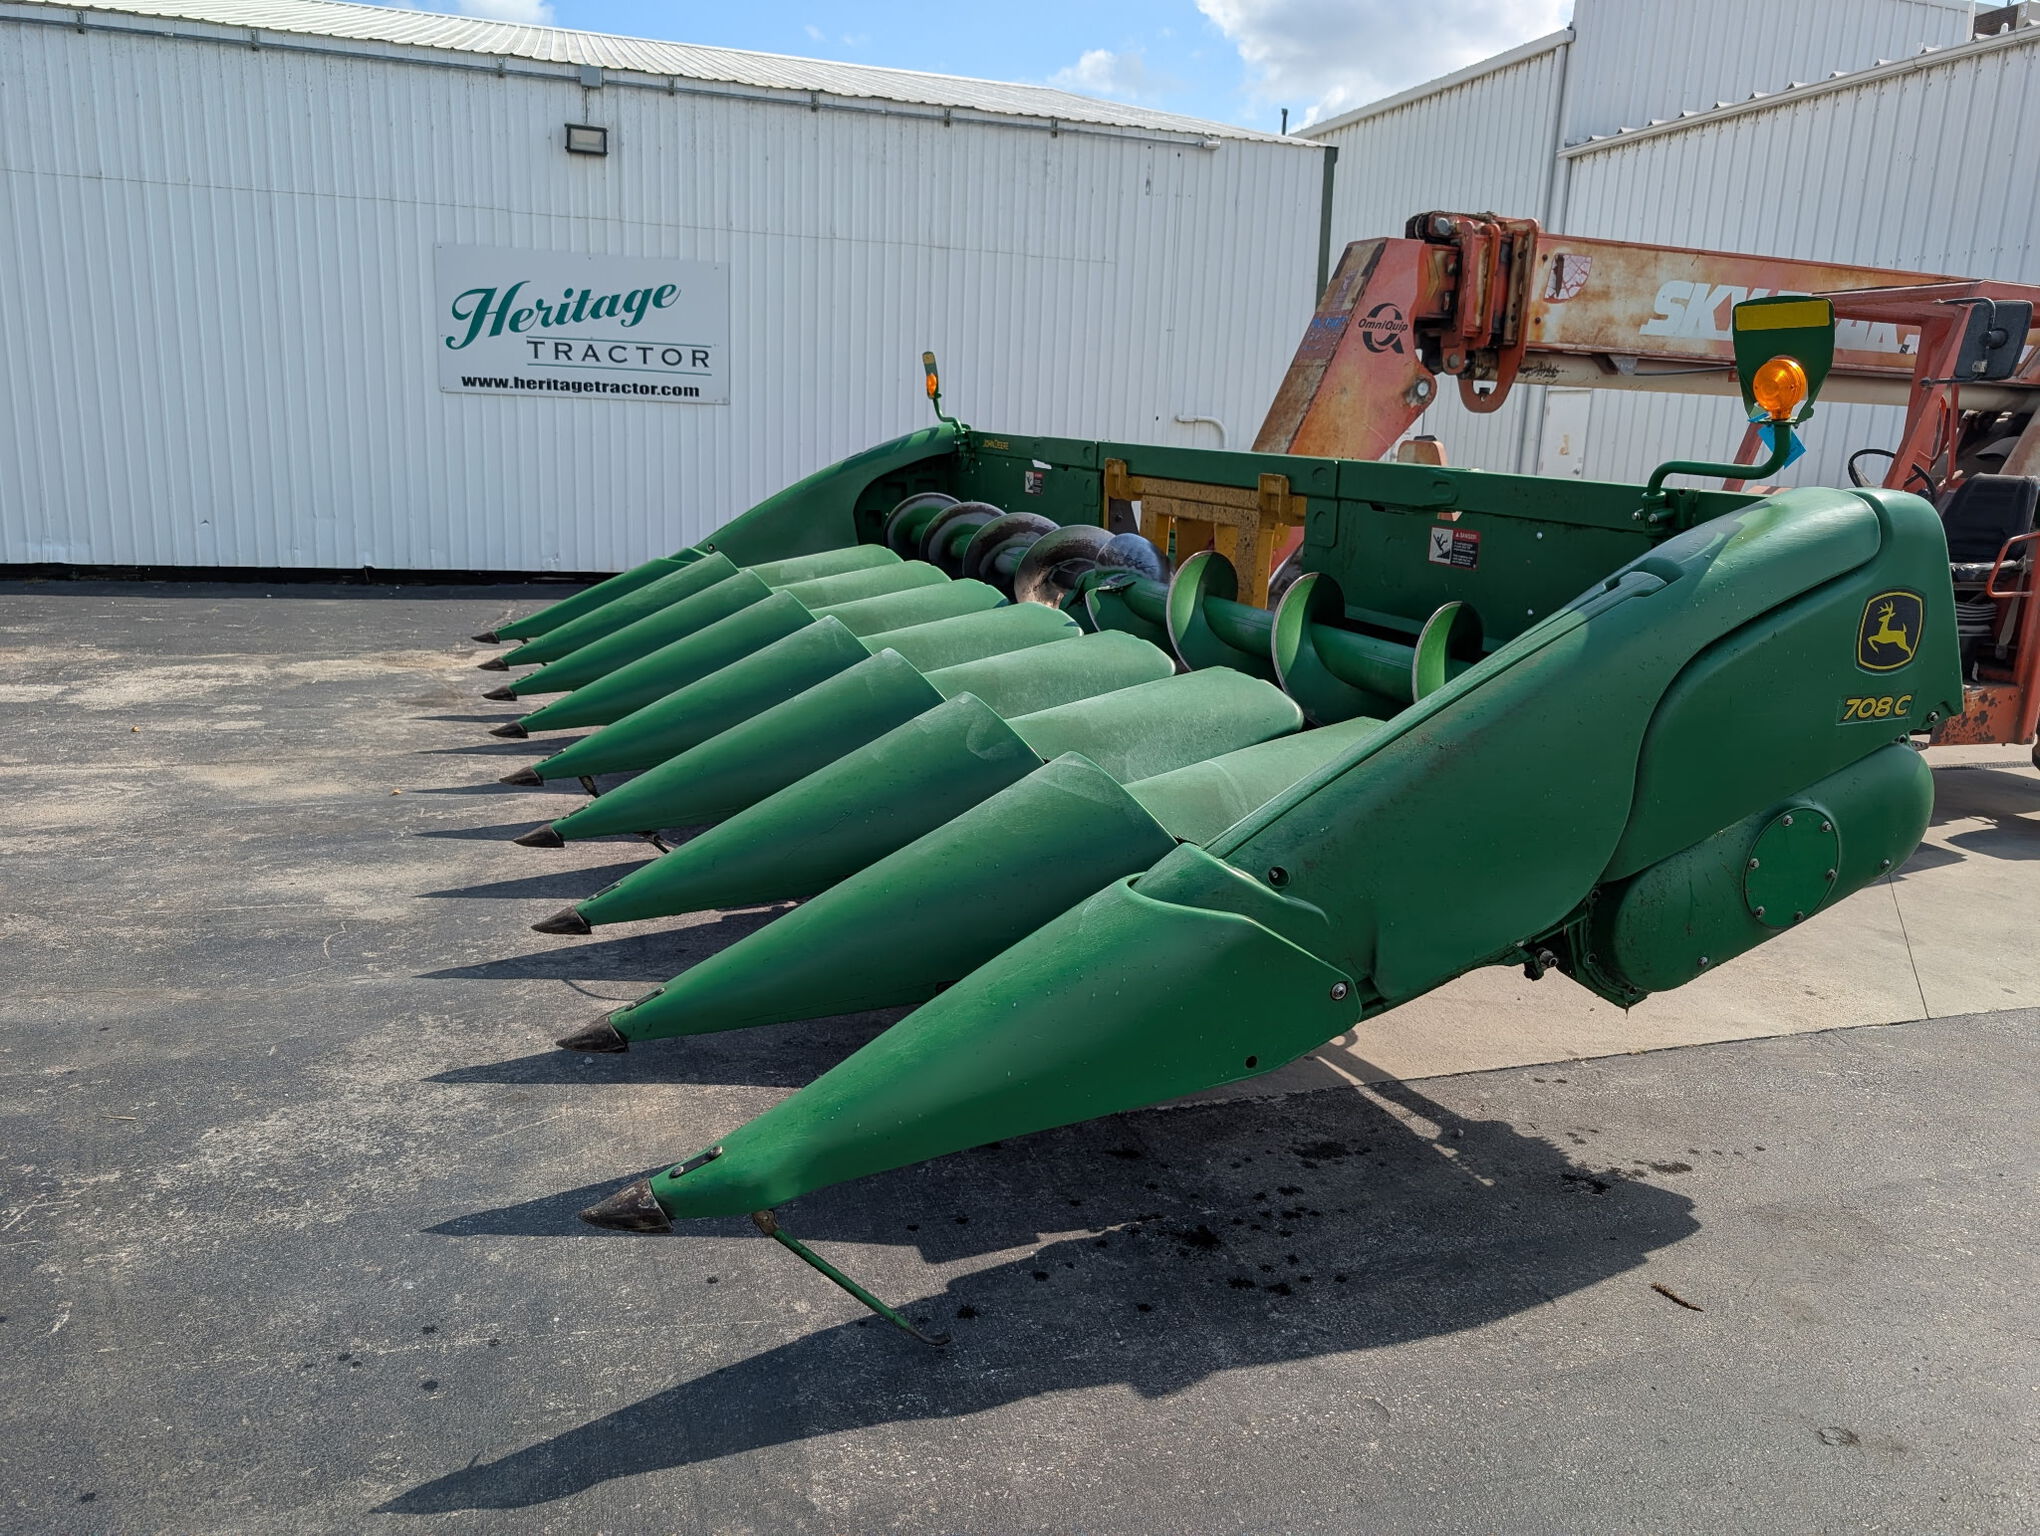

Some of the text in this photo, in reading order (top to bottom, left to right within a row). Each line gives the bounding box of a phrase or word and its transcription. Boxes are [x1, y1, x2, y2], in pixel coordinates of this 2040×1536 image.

[445, 280, 682, 350] Heritage
[1358, 319, 1409, 333] OmniQuip
[526, 340, 710, 368] TRACTOR
[461, 376, 700, 398] www.heritagetractor.com
